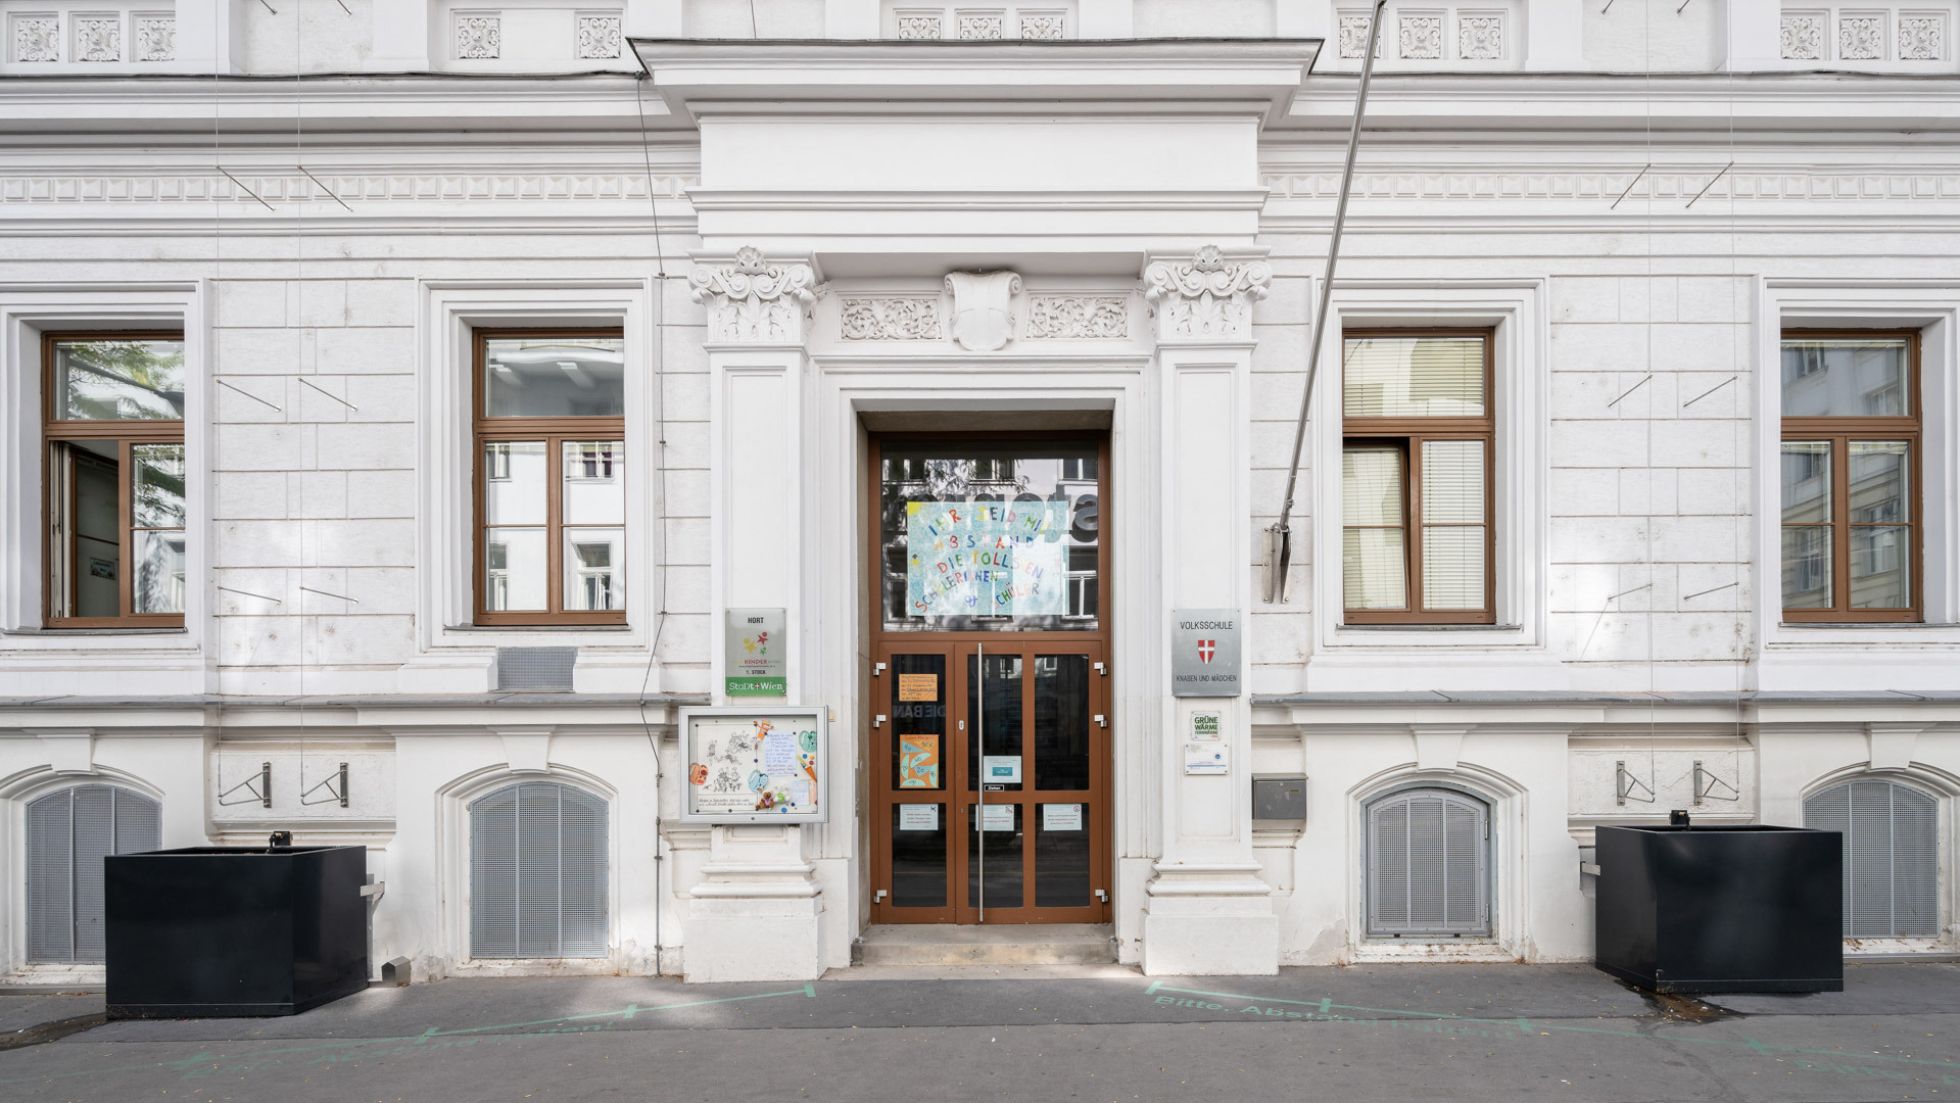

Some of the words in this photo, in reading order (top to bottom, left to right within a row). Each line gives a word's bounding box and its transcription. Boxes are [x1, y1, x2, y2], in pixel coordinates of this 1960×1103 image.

[936, 554, 964, 574] DIE
[747, 616, 764, 624] HORT
[1180, 621, 1233, 630] VOLKSSCHULE
[1194, 716, 1219, 724] GRÜNE
[1194, 723, 1218, 731] WÄRME
